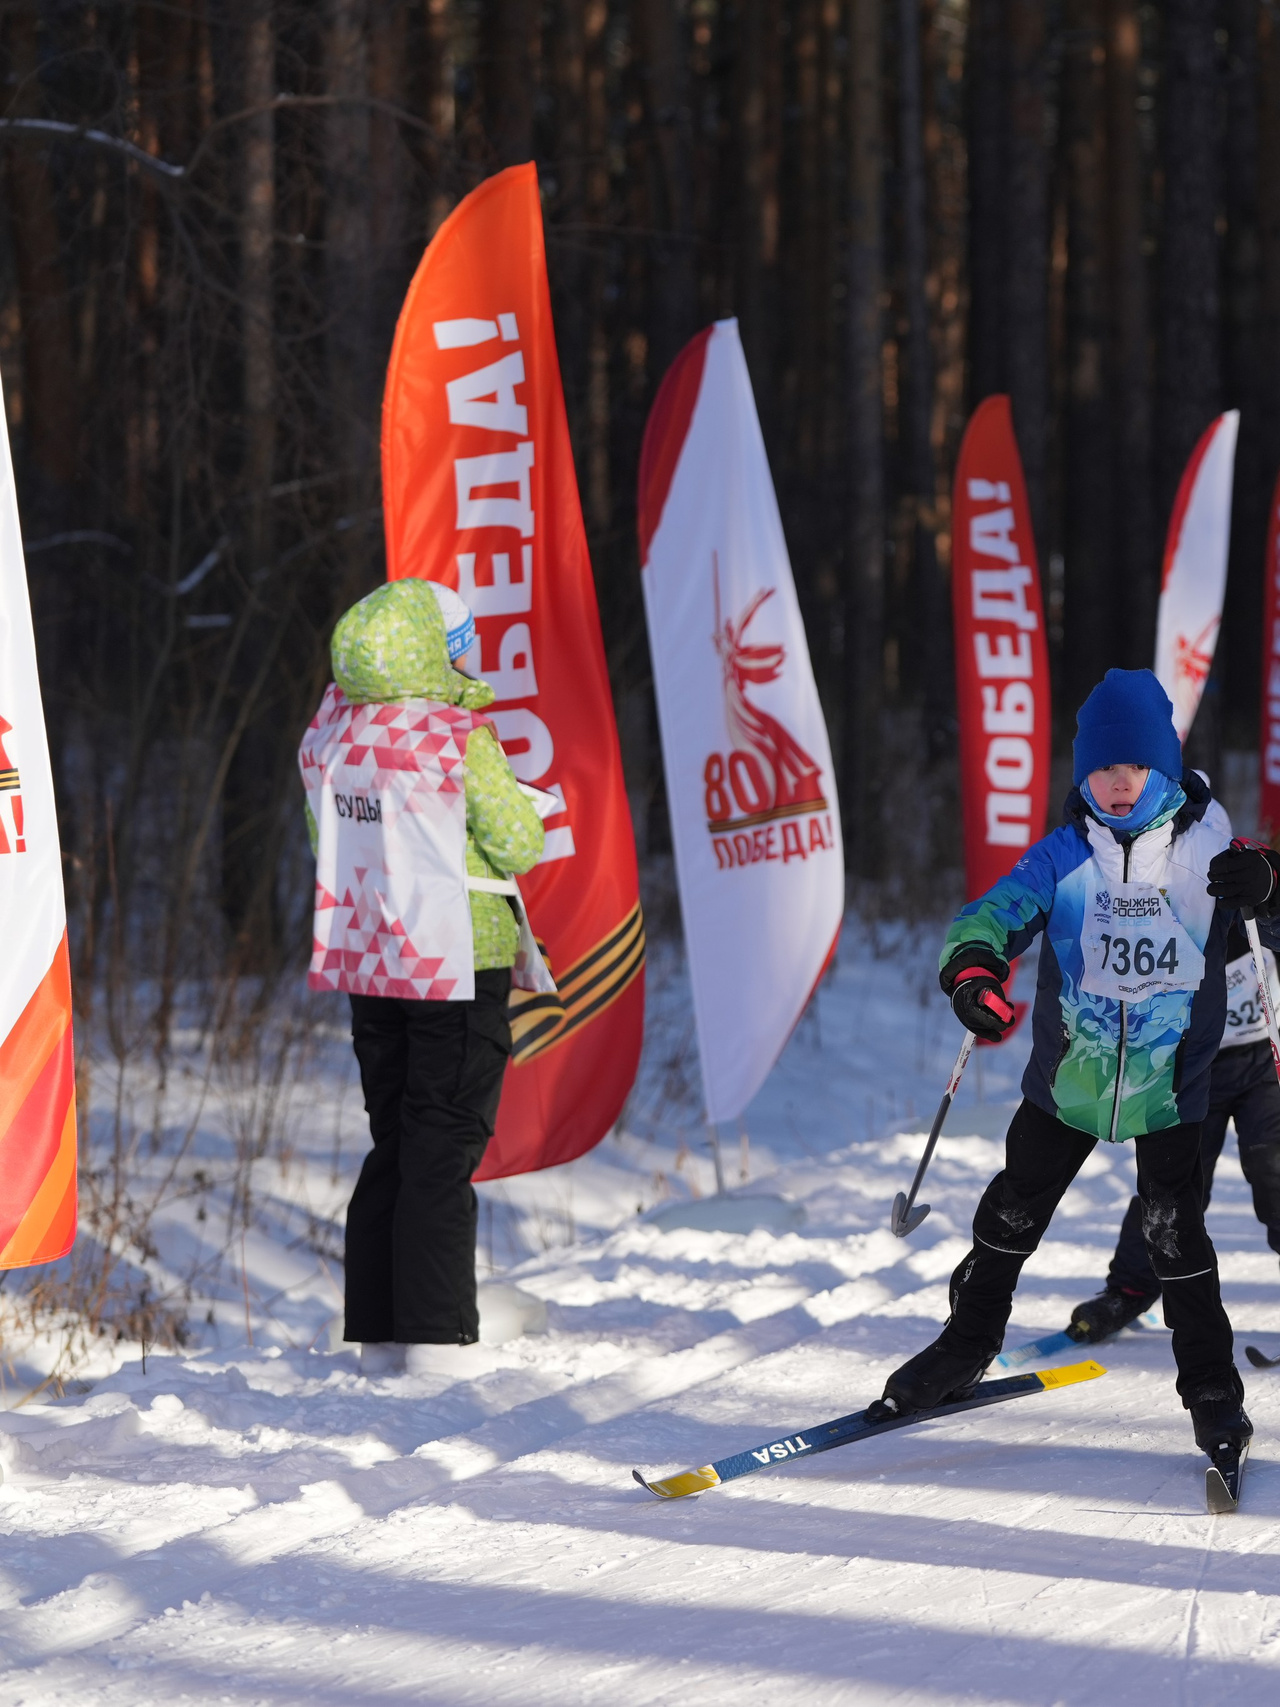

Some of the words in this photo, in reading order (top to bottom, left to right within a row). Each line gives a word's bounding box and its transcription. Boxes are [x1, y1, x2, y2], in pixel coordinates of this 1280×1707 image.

[968, 478, 1037, 848] ПОБЕДА!
[704, 752, 772, 822] 80
[334, 793, 383, 824] СУДЬЯ
[713, 814, 834, 870] ПОБЕДА!
[1113, 897, 1159, 908] ЛЫЖНЯ
[1113, 907, 1161, 917] РОССИИ
[751, 1436, 812, 1464] TISA
